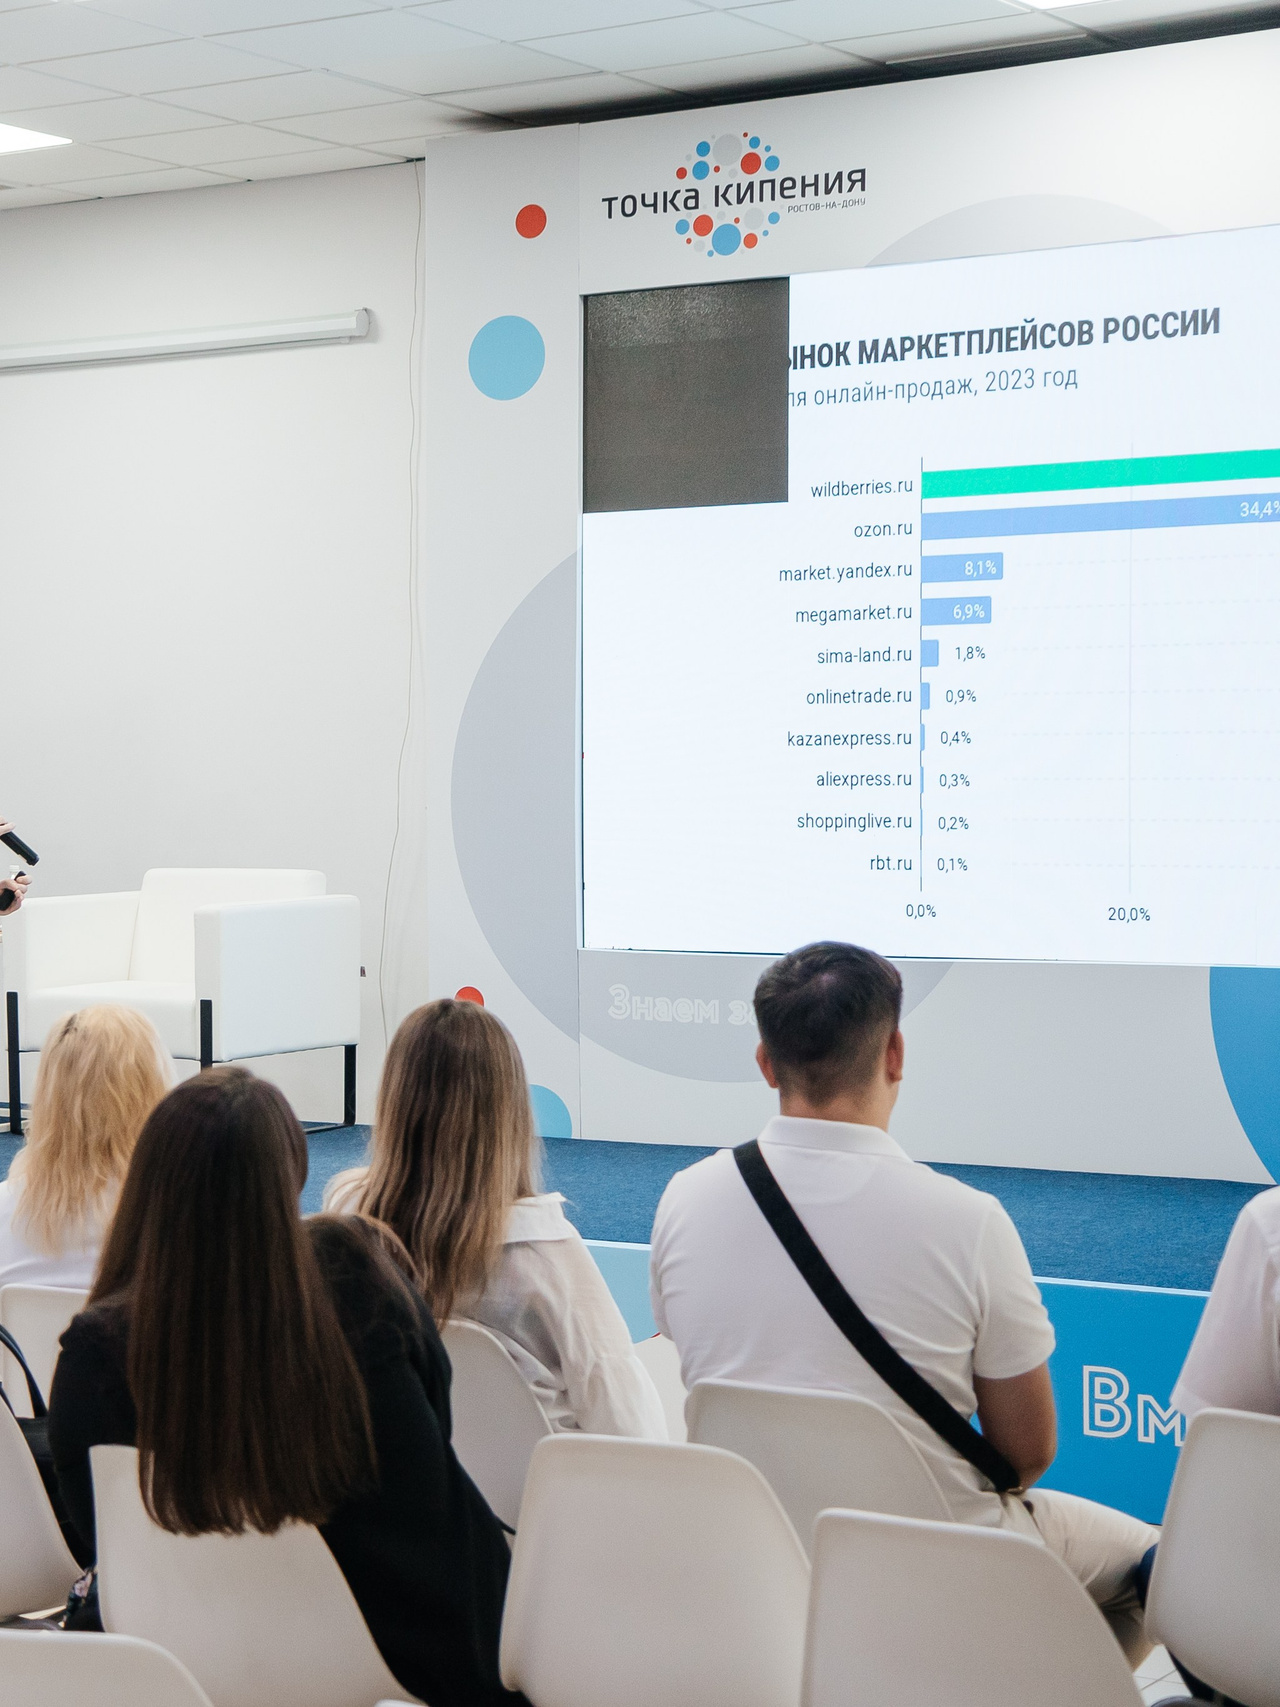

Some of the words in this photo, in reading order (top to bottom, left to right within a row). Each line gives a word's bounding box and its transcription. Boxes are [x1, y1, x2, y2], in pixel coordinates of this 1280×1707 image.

[787, 198, 866, 214] РОСТОВ-НА-ДОНУ
[858, 318, 1095, 366] МАРКЕТПЛЕЙСОВ
[1102, 307, 1220, 344] РОССИИ
[813, 377, 979, 406] онлайн-продаж,
[985, 367, 1036, 392] 2023
[1043, 369, 1079, 390] год
[810, 479, 914, 498] wildberries.ru
[853, 521, 914, 538] ozon.ru
[778, 561, 913, 583] market.yandex.ru
[963, 559, 998, 578] 8,1%
[795, 604, 913, 626] megamarket.ru
[952, 604, 986, 622] 6,9%
[817, 646, 913, 664] sima-land.ru
[954, 646, 987, 663] 1,8%
[805, 687, 913, 705] onlinetrade.ru
[945, 689, 978, 706] 0,9%
[787, 731, 913, 750] kazanexpress.ru
[939, 731, 973, 747] 0,4%
[816, 771, 913, 791] aliexpress.ru
[938, 773, 972, 790] 0,3%
[796, 813, 913, 833] shoppinglive.ru
[937, 816, 971, 833] 0,2%
[869, 854, 913, 871] rbt.ru
[936, 857, 969, 874] 0,1%
[905, 903, 938, 920] 0,0%
[1107, 906, 1152, 924] 20,0%
[607, 983, 721, 1025] Знаем
